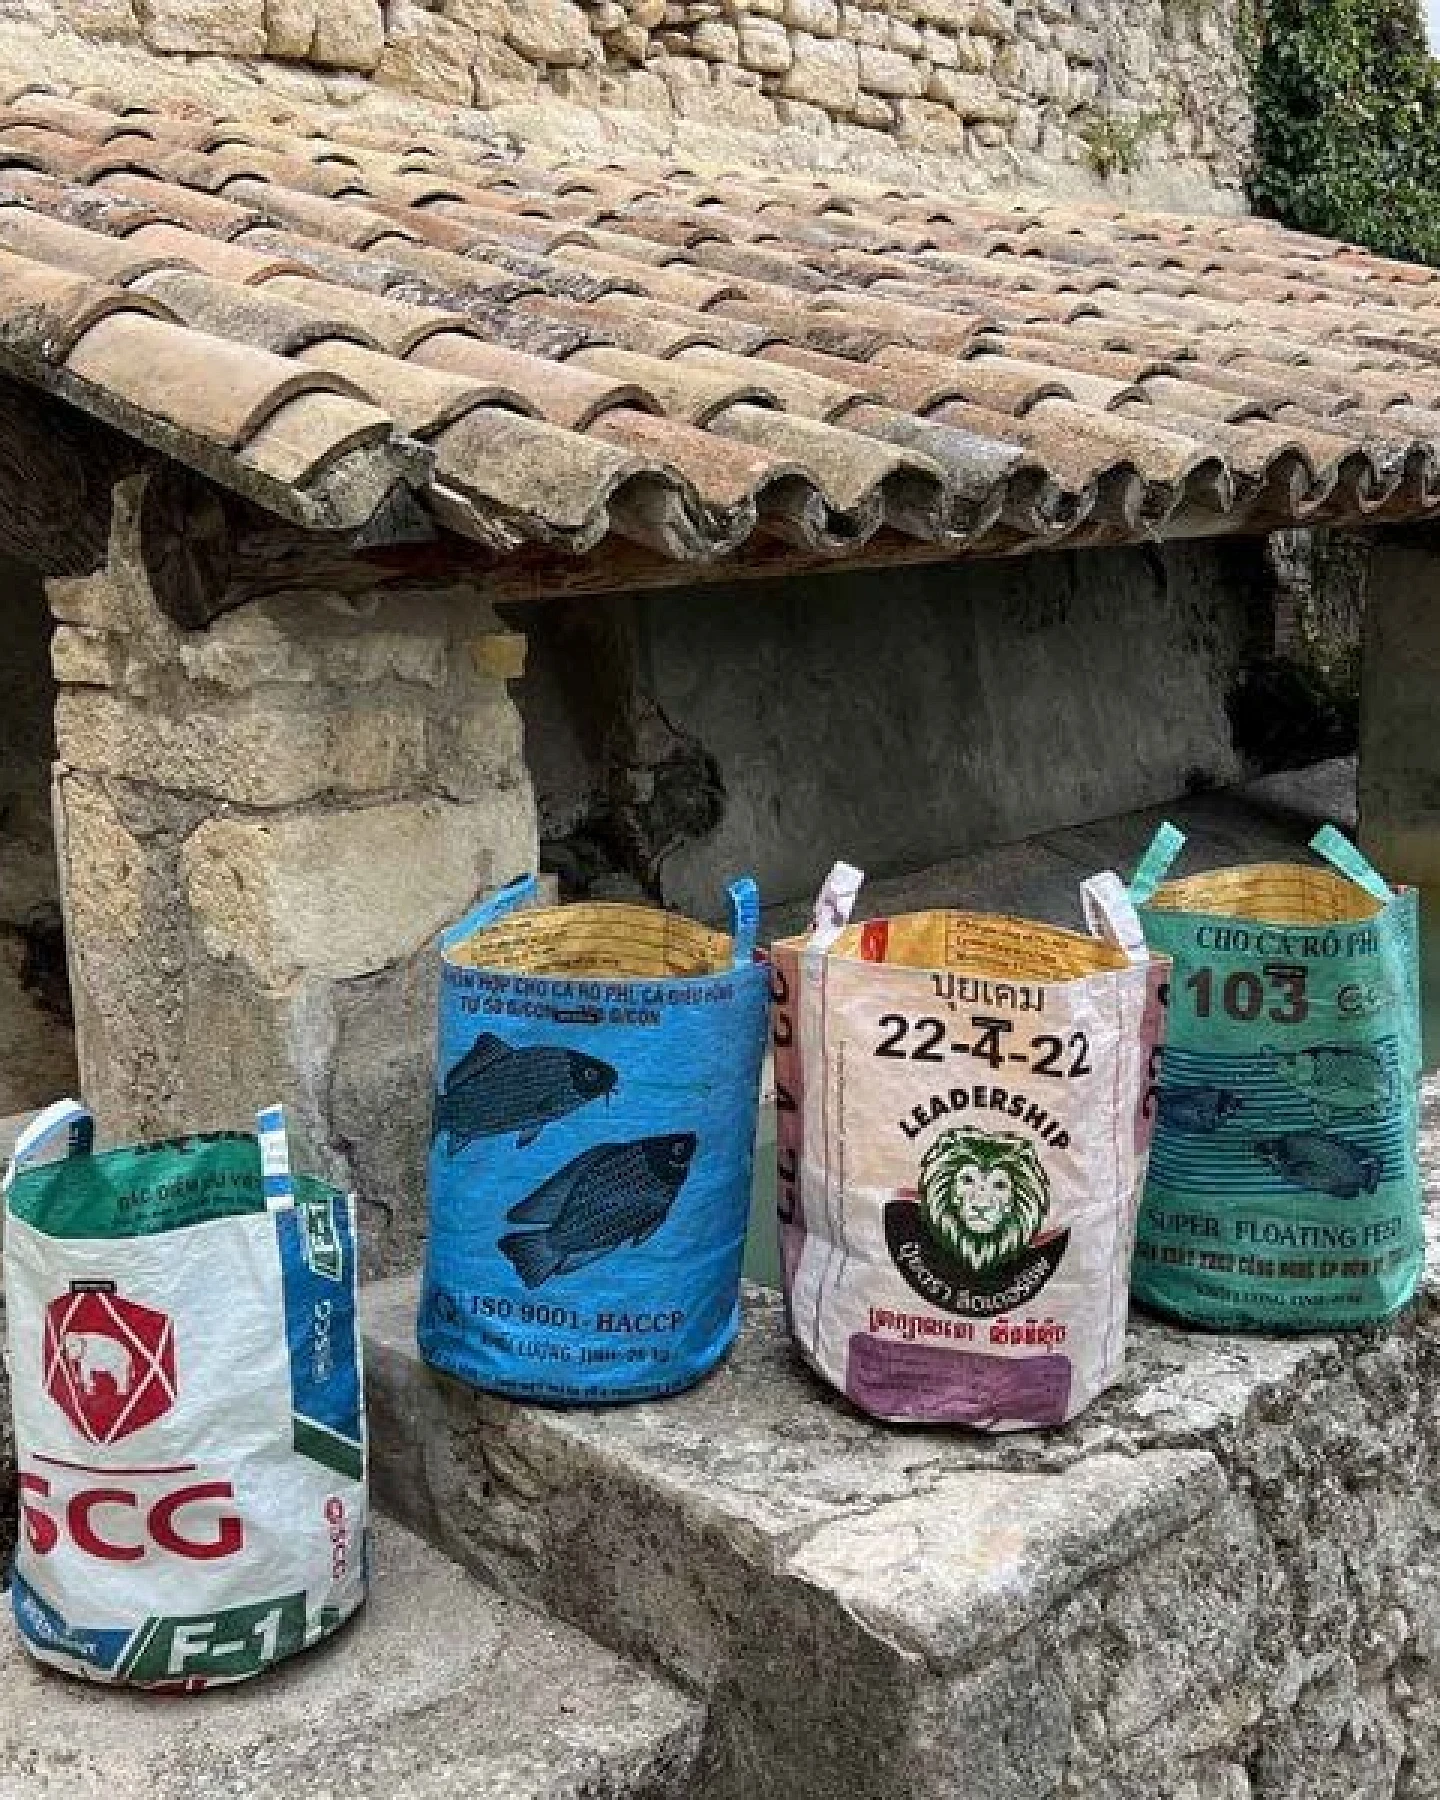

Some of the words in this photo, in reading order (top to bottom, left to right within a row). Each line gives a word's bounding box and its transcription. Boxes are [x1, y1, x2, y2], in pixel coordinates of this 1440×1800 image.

[1196, 925, 1250, 951] CHO
[1302, 927, 1340, 957] RÔ
[1186, 965, 1309, 1023] 103
[874, 1013, 1092, 1078] 22-4-22
[898, 1085, 1072, 1150] LEADERSHIP
[1149, 1209, 1219, 1237] SUPER
[1235, 1220, 1356, 1249] FLOATING
[471, 1295, 513, 1319] ISO
[596, 1310, 686, 1333] HACCP
[18, 1472, 243, 1561] SCG
[167, 1608, 282, 1675] F-1
